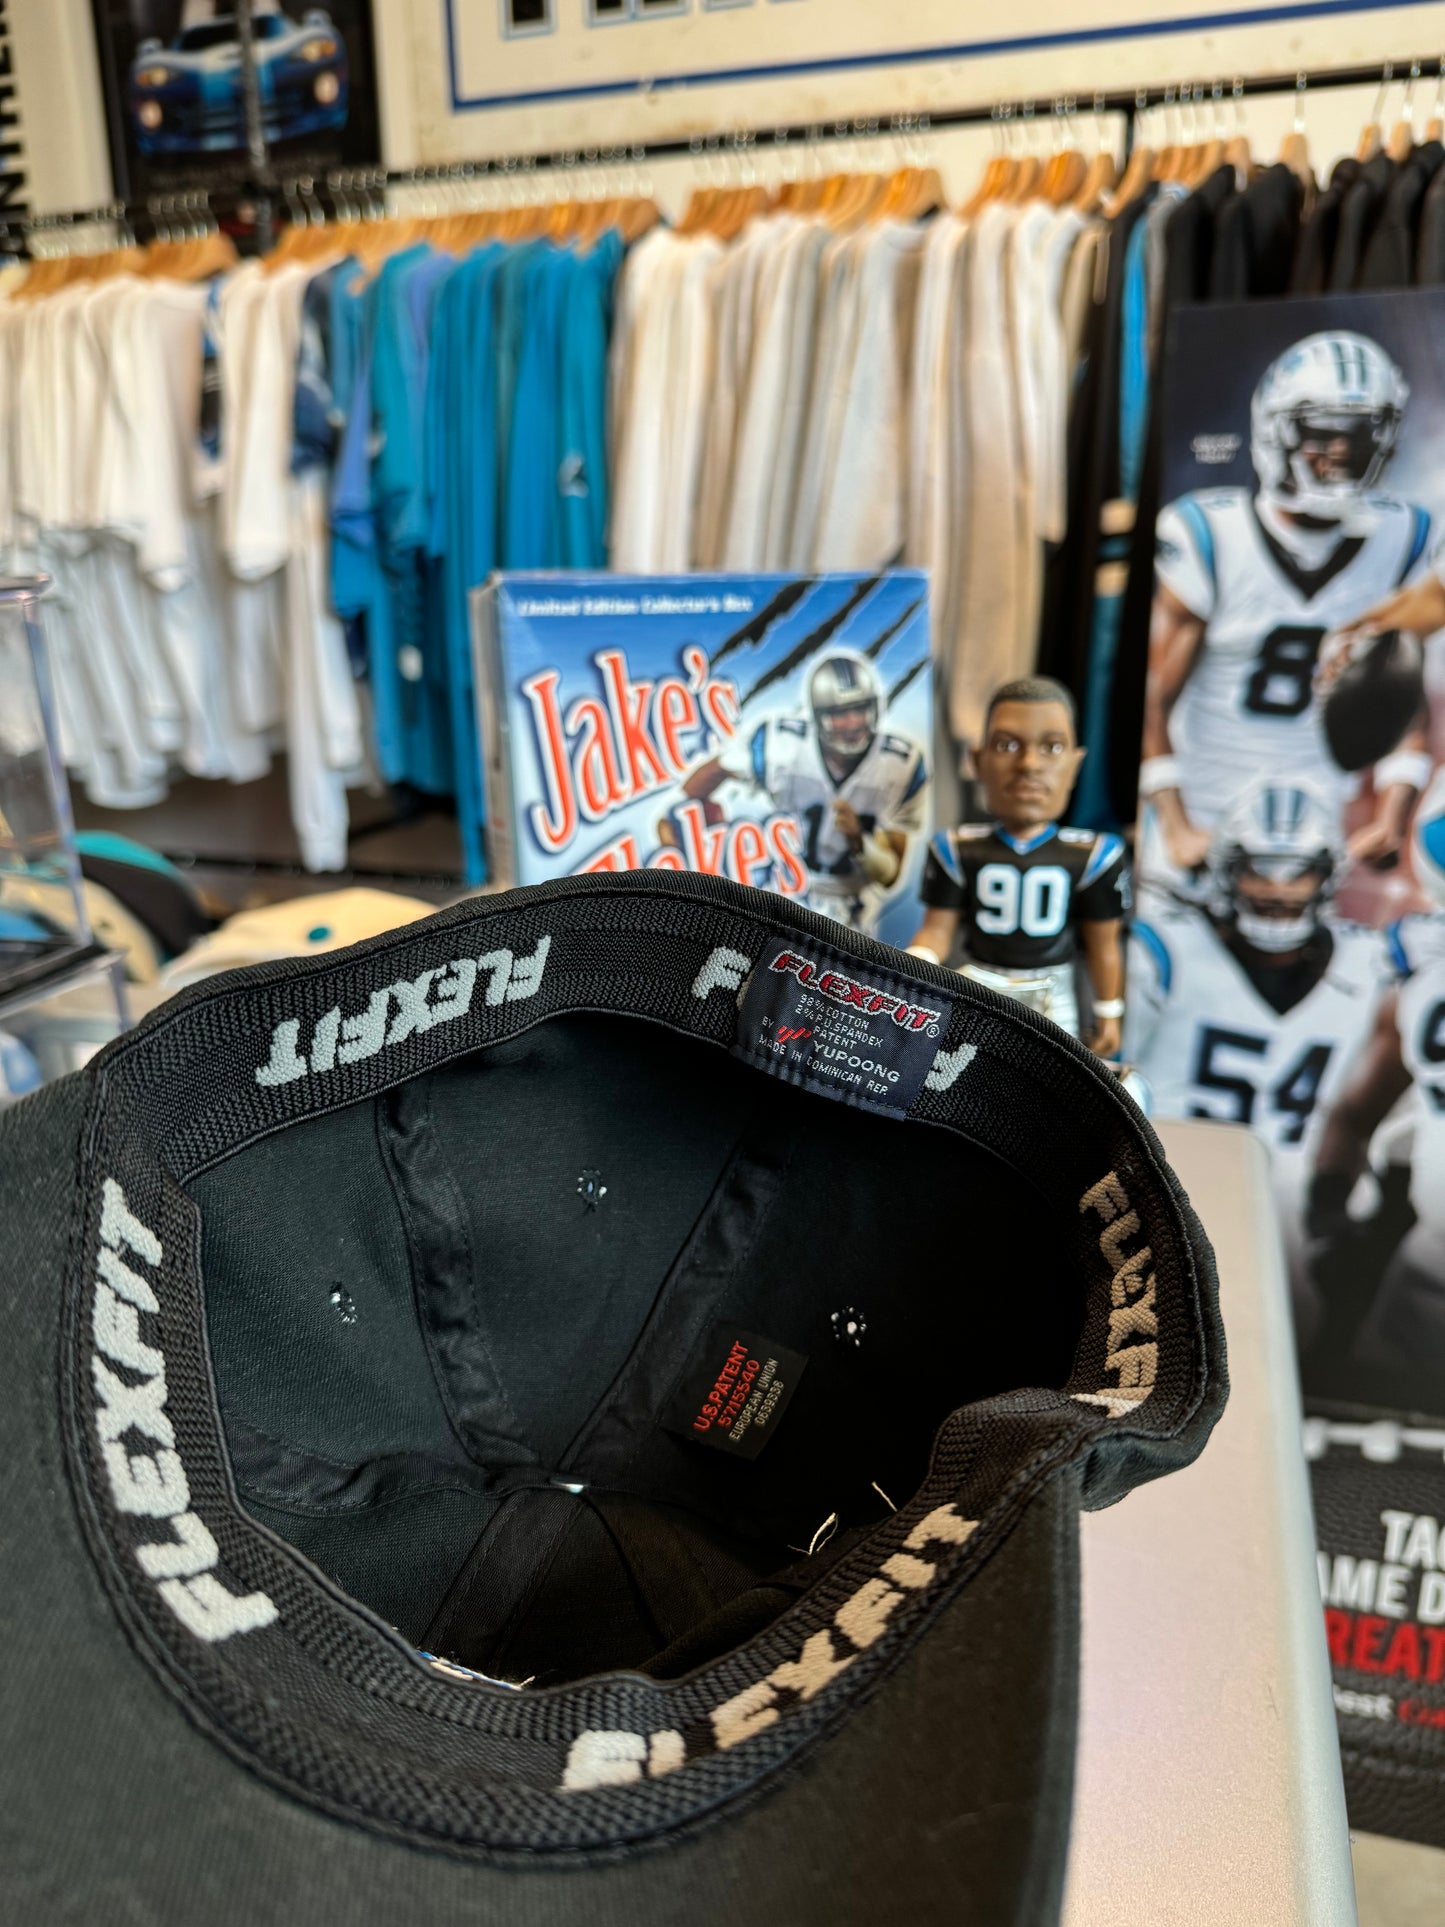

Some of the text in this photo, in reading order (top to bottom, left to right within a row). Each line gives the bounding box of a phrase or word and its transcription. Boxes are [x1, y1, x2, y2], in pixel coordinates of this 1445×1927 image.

[976, 863, 1071, 937] 90
[255, 935, 552, 1087] FLEXFIT
[813, 1026, 858, 1050] PATENT
[826, 1005, 870, 1030] COTTON
[759, 1034, 785, 1055] MADE
[790, 1050, 802, 1062] IN
[806, 1056, 861, 1085] DOMINICAN
[762, 1016, 774, 1029] BY
[813, 1040, 900, 1083] YUPOONG
[1189, 1026, 1334, 1144] 54
[91, 1176, 280, 1642] FLEXFIT
[717, 1360, 760, 1428] 5715540
[729, 1358, 779, 1440] EUROPEAN UNION
[1381, 1509, 1445, 1571] TA
